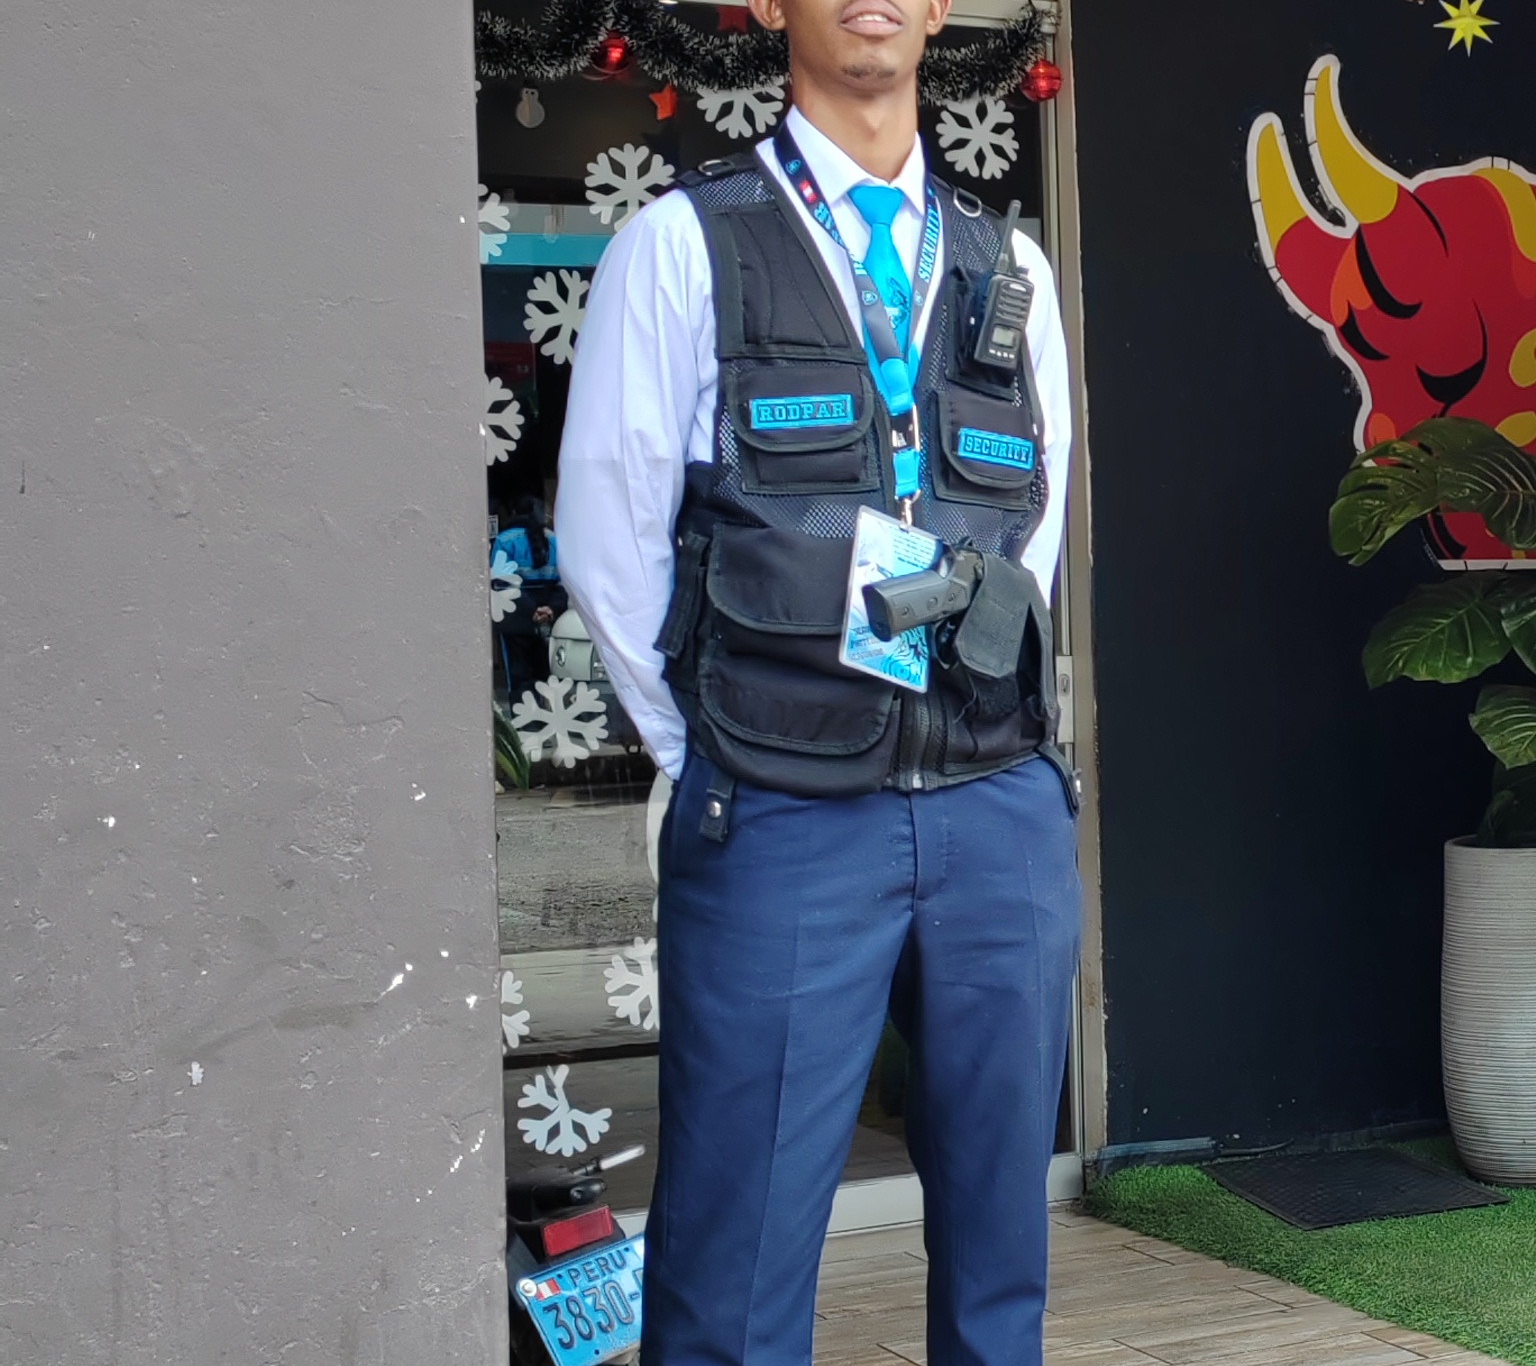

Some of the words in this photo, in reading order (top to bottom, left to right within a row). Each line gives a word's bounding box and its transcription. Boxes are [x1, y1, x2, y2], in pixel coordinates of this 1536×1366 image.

[918, 203, 940, 284] SECURITY
[758, 401, 846, 424] RODPAR
[963, 436, 1031, 463] SECURITY
[568, 1249, 627, 1286] PERU
[542, 1268, 645, 1351] 3830-
